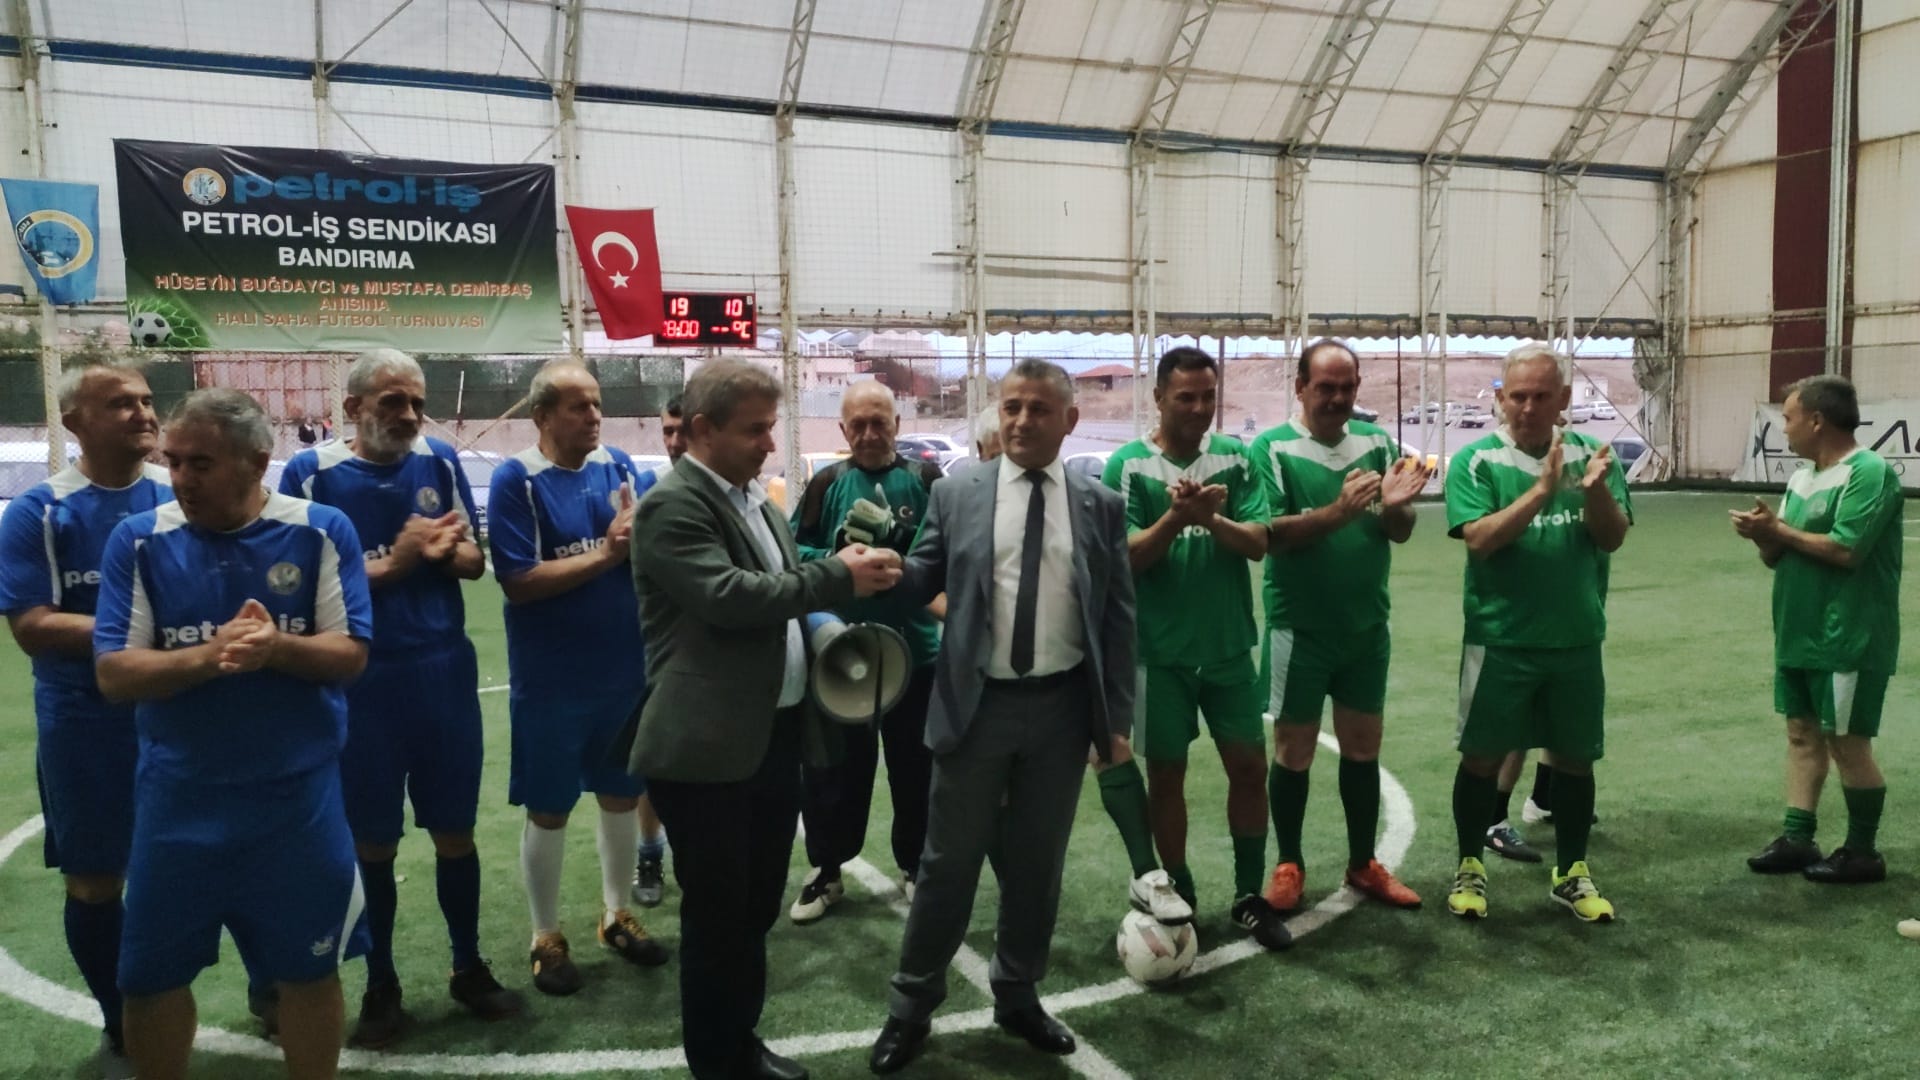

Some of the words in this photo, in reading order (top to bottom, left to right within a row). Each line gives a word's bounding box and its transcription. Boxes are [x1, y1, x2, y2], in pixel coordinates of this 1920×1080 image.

[182, 210, 341, 244] PETROL-İŞ
[348, 216, 497, 245] SENDİKASI
[278, 246, 415, 270] BANDIRMA
[155, 272, 237, 292] HÜSEYİN
[240, 276, 336, 294] BUĞDAYCI
[364, 280, 447, 297] MUSTAFA
[450, 281, 533, 300] DEMİRBAŞ
[671, 297, 689, 316] 19
[725, 298, 743, 316] 10
[262, 312, 314, 329] SAHA
[317, 314, 388, 329] FUTBOL
[390, 314, 488, 331] TURNUVASI
